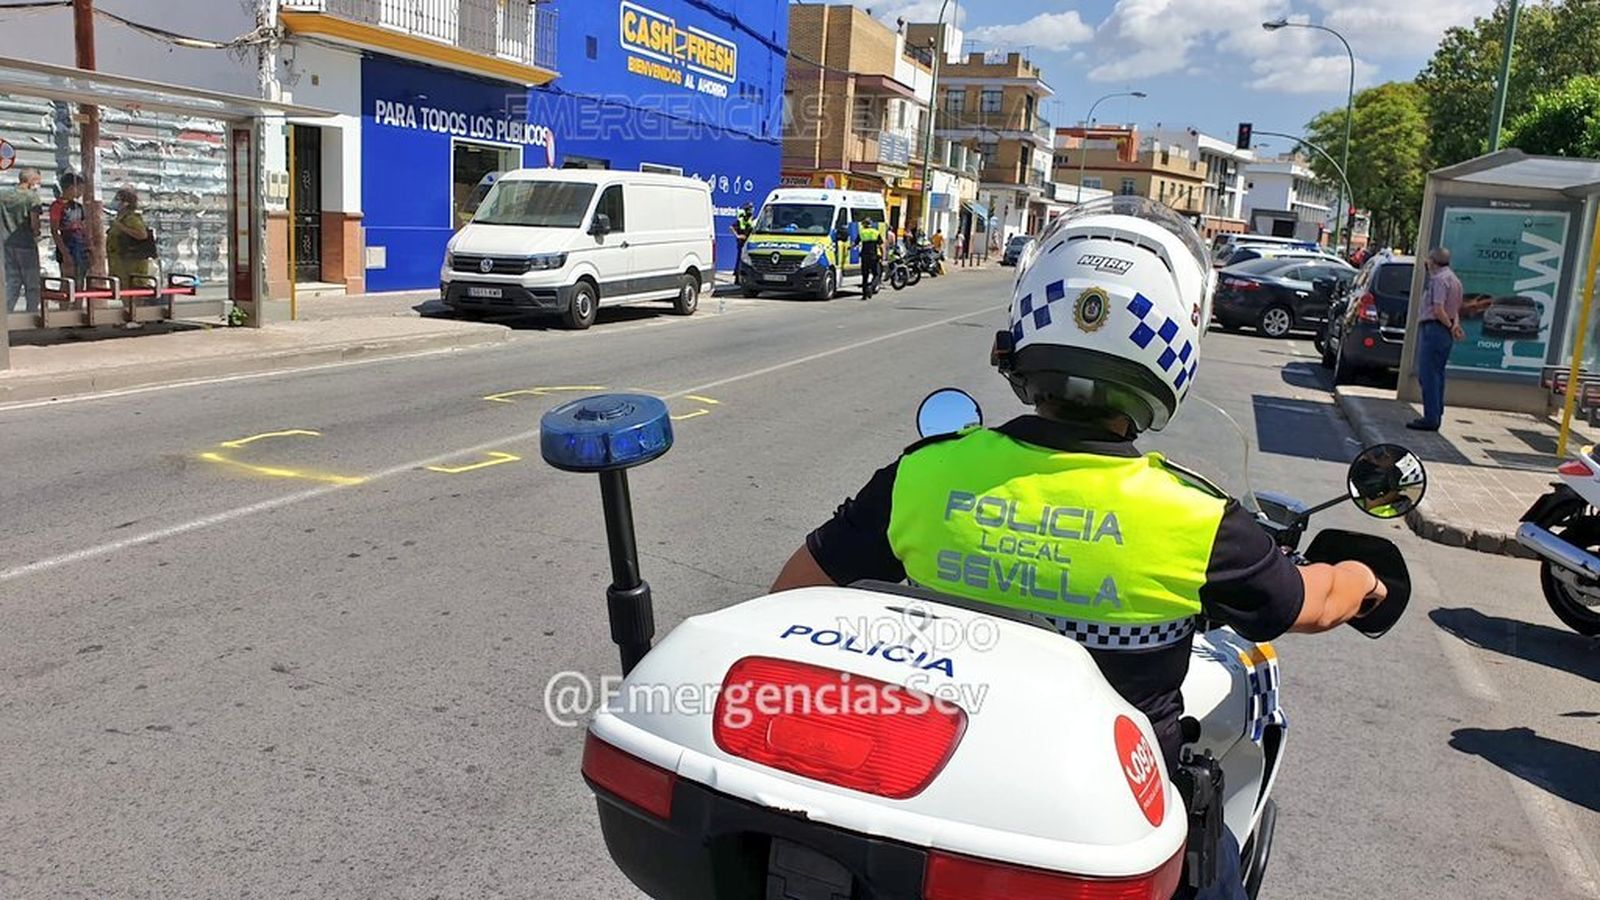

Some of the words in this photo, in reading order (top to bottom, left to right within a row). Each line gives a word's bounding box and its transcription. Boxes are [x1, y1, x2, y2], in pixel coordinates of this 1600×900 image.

[624, 10, 673, 55] CASH
[687, 33, 734, 75] FRESH
[627, 55, 682, 85] BIENVENIDOS
[684, 73, 696, 90] AL
[697, 77, 728, 99] AHORRO
[375, 99, 417, 129] PARA
[420, 107, 468, 136] TODOS
[470, 115, 494, 139] LOS
[496, 115, 550, 148] PÚBLICOS
[1078, 254, 1133, 272] NOLAN
[1477, 340, 1502, 349] now
[943, 489, 1123, 546] POLICIA
[979, 529, 1072, 565] LOCAL
[936, 549, 1122, 608] SEVILLA
[780, 623, 955, 678] POLICIA
